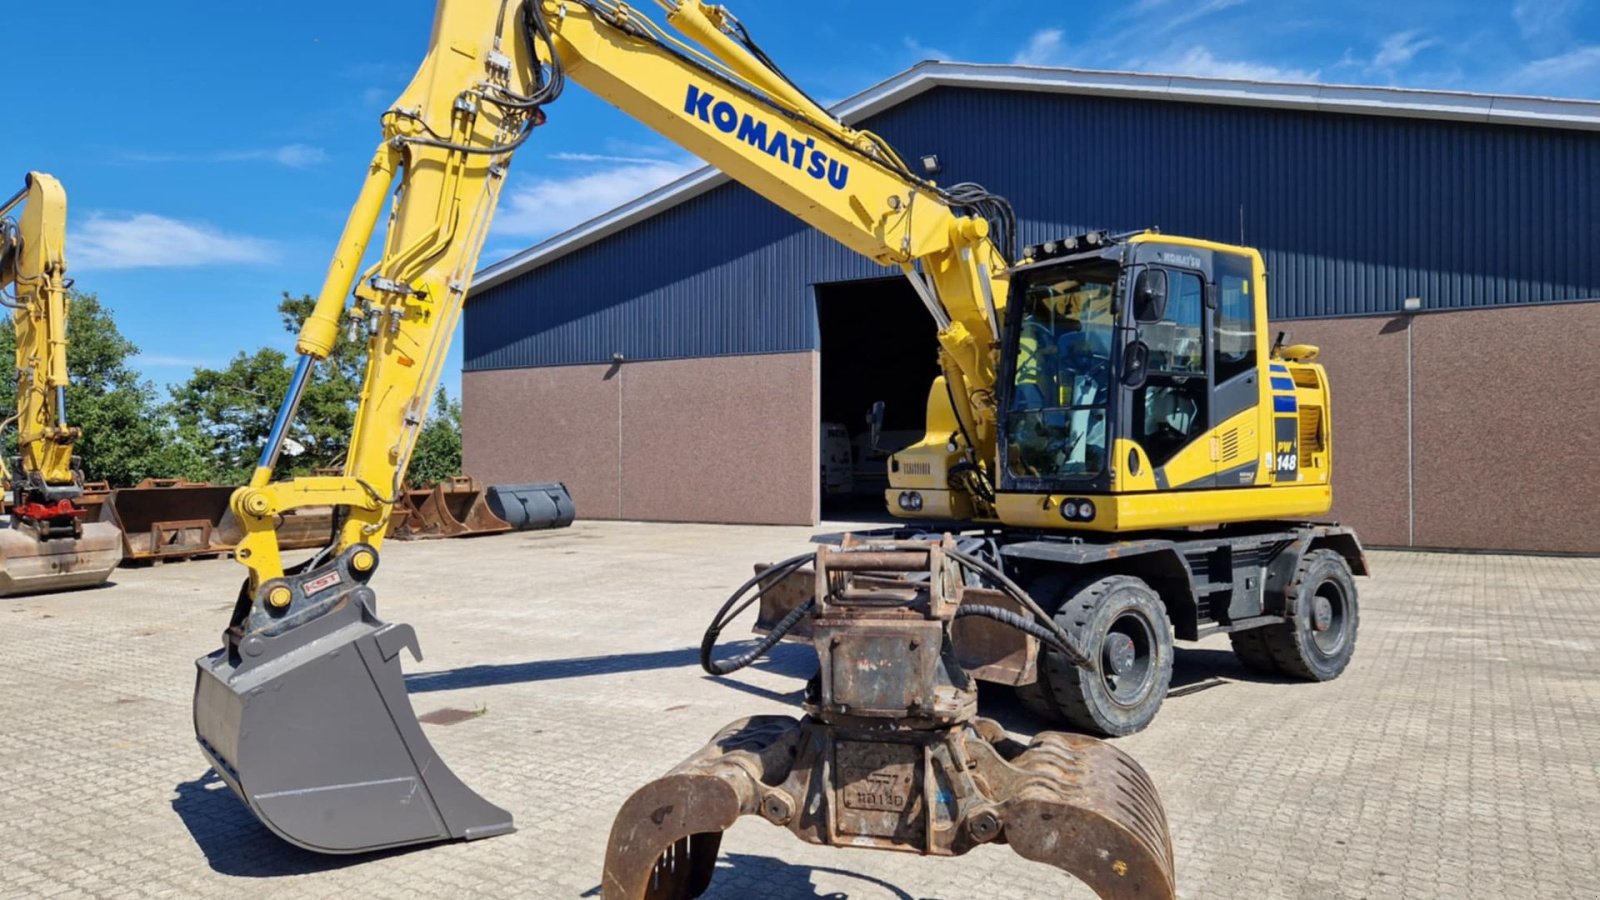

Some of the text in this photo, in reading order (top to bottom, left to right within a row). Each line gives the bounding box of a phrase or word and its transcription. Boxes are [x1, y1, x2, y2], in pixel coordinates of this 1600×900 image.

[684, 84, 849, 190] KOMATSU
[1163, 252, 1201, 268] KOMATSU
[1277, 441, 1293, 453] PW
[1277, 454, 1297, 471] 148
[305, 572, 337, 592] KST
